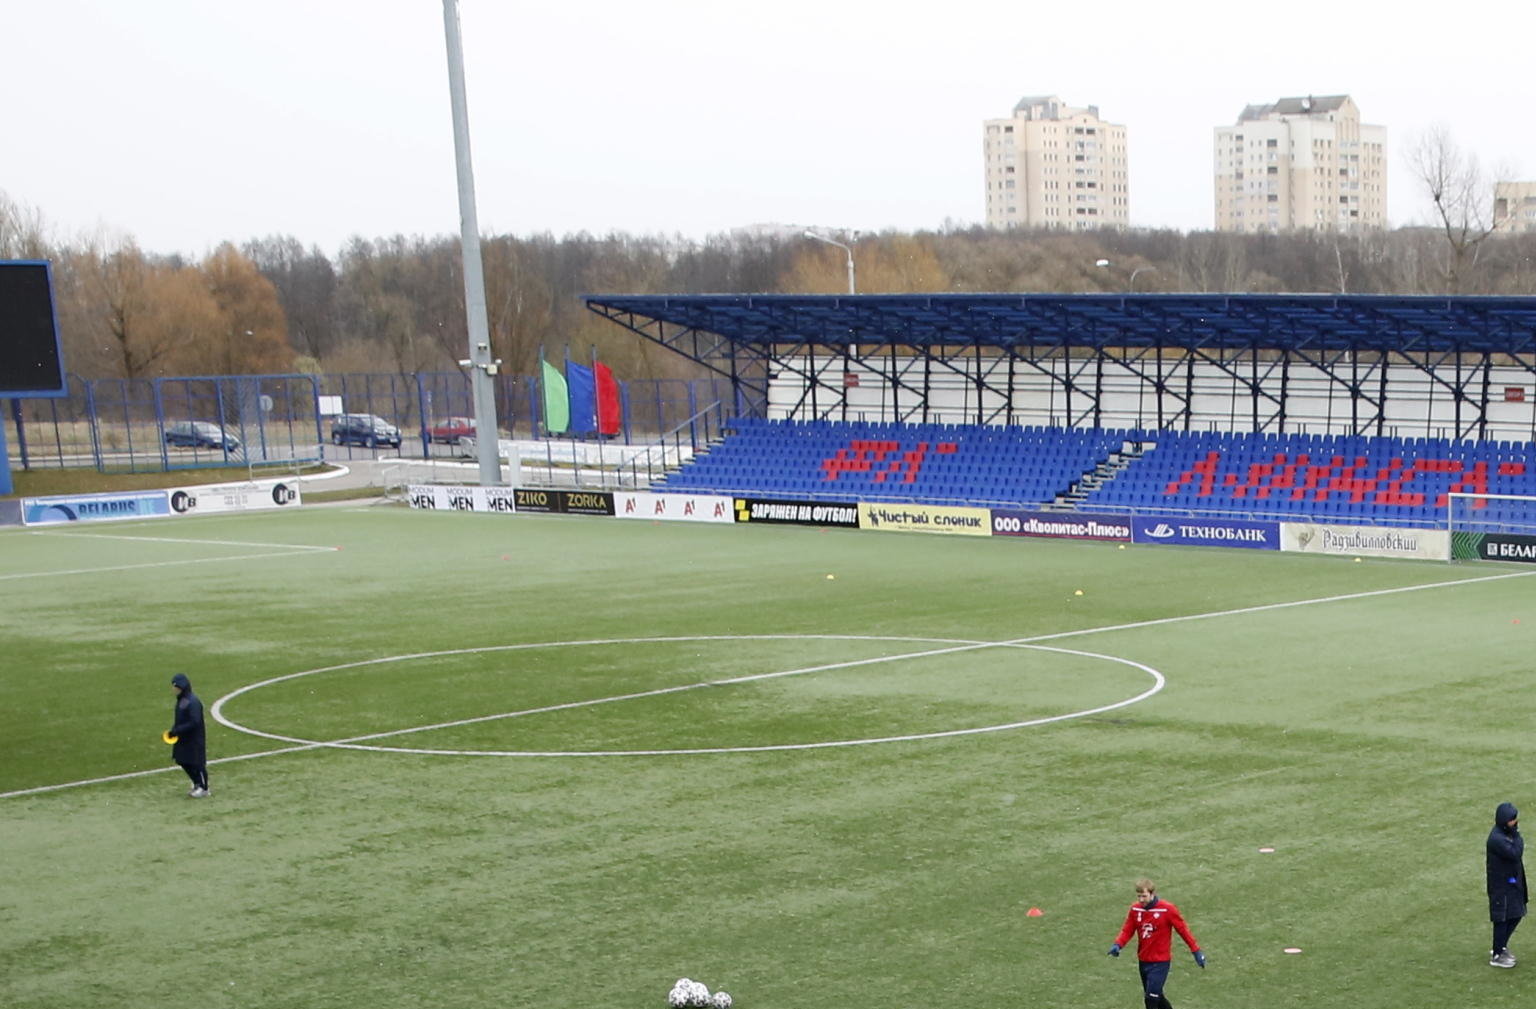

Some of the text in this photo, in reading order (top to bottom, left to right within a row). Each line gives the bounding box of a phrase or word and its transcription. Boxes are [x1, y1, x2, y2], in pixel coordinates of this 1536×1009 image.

[412, 494, 436, 509] MEN
[449, 496, 474, 511] MEN
[487, 497, 513, 512] MEN
[517, 491, 548, 506] ZIKO
[566, 493, 607, 509] ZORKA
[751, 502, 857, 523] ЗАРЯЖЕН НА ФУТБОЛ!
[879, 508, 982, 529] Чистый слоник
[994, 517, 1020, 532] ООО
[1179, 525, 1266, 542] ТЕХНОБАНК
